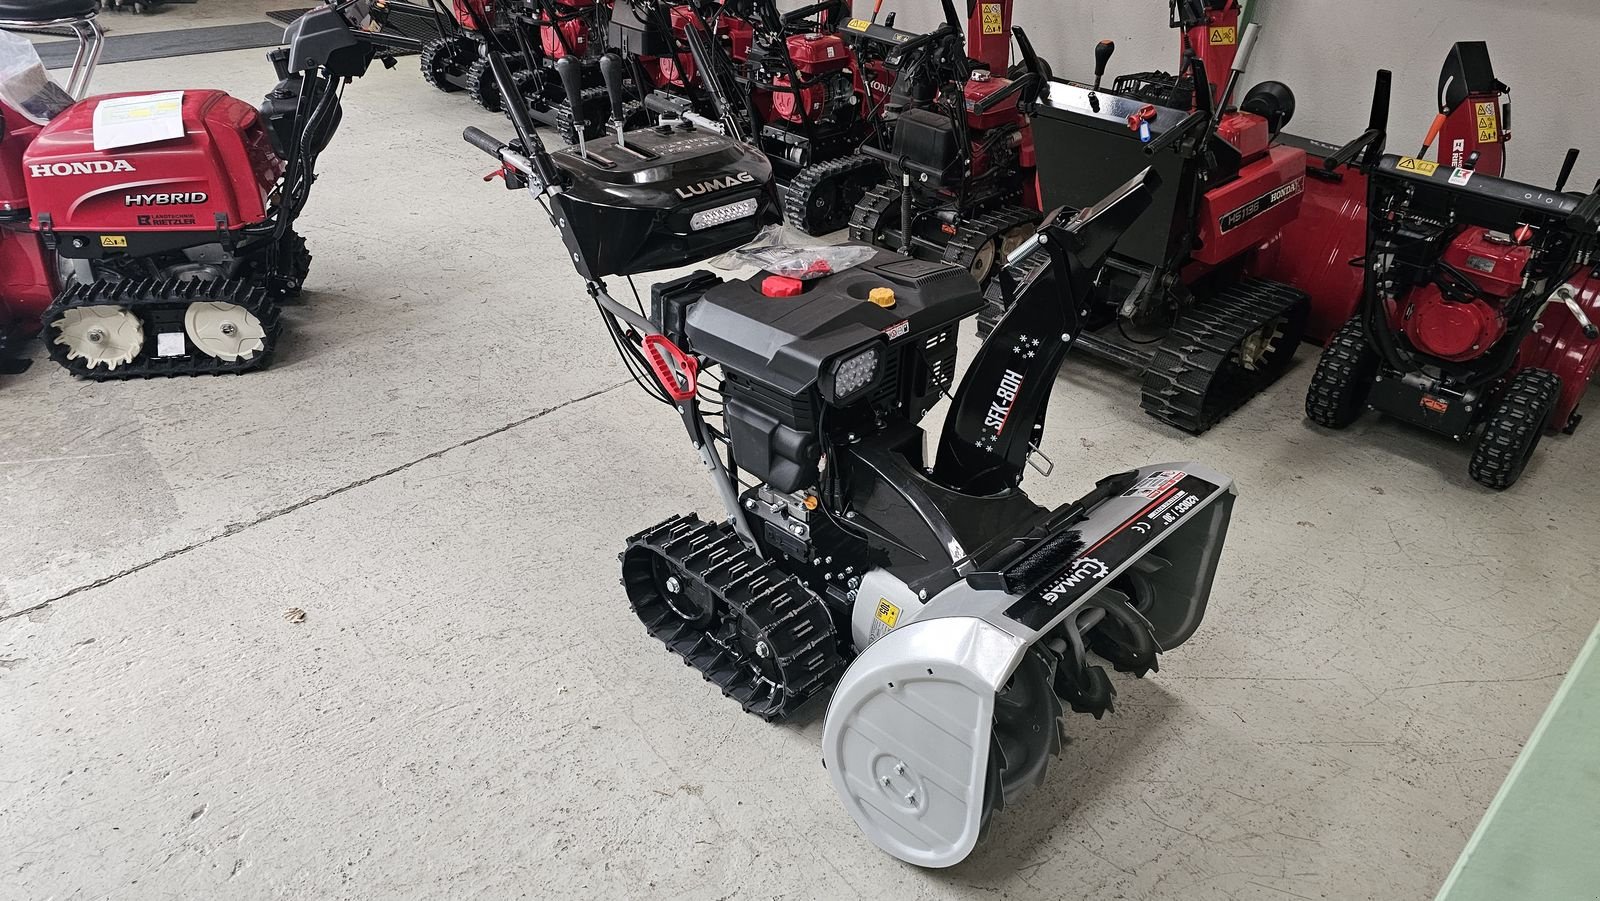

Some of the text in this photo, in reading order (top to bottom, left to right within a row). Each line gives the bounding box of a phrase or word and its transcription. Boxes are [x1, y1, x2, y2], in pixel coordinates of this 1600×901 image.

[28, 160, 136, 178] HONDA
[675, 171, 755, 199] LUMAG
[1270, 183, 1296, 203] HONDA
[124, 192, 208, 207] HYBRID
[984, 368, 1024, 430] SFK-80H
[1174, 494, 1200, 514] 420CC
[1042, 562, 1098, 603] LUMAG
[879, 602, 891, 616] 105
